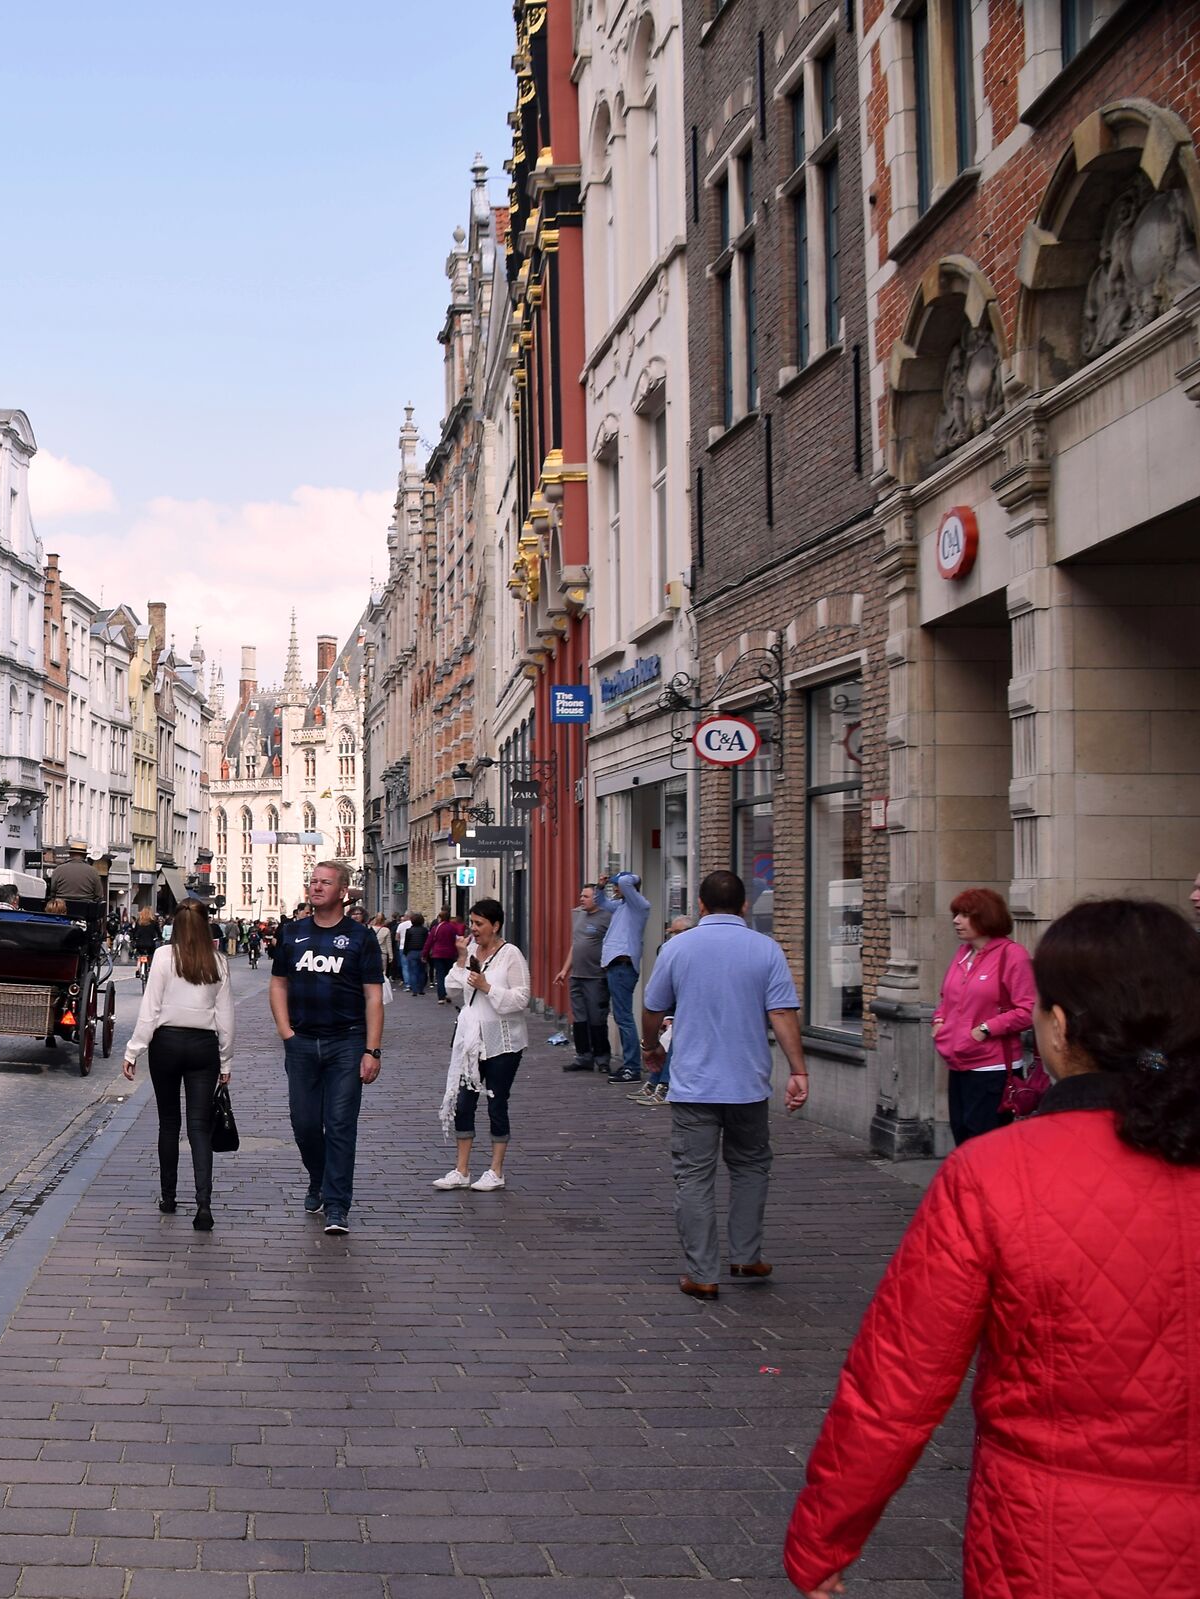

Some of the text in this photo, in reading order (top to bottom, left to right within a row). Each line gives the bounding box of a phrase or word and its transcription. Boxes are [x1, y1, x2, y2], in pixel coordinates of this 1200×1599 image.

[942, 524, 961, 560] C&A
[555, 692, 574, 700] The
[556, 706, 584, 714] House
[705, 729, 748, 752] C&A
[513, 791, 538, 799] ZARA
[295, 950, 344, 973] AON
